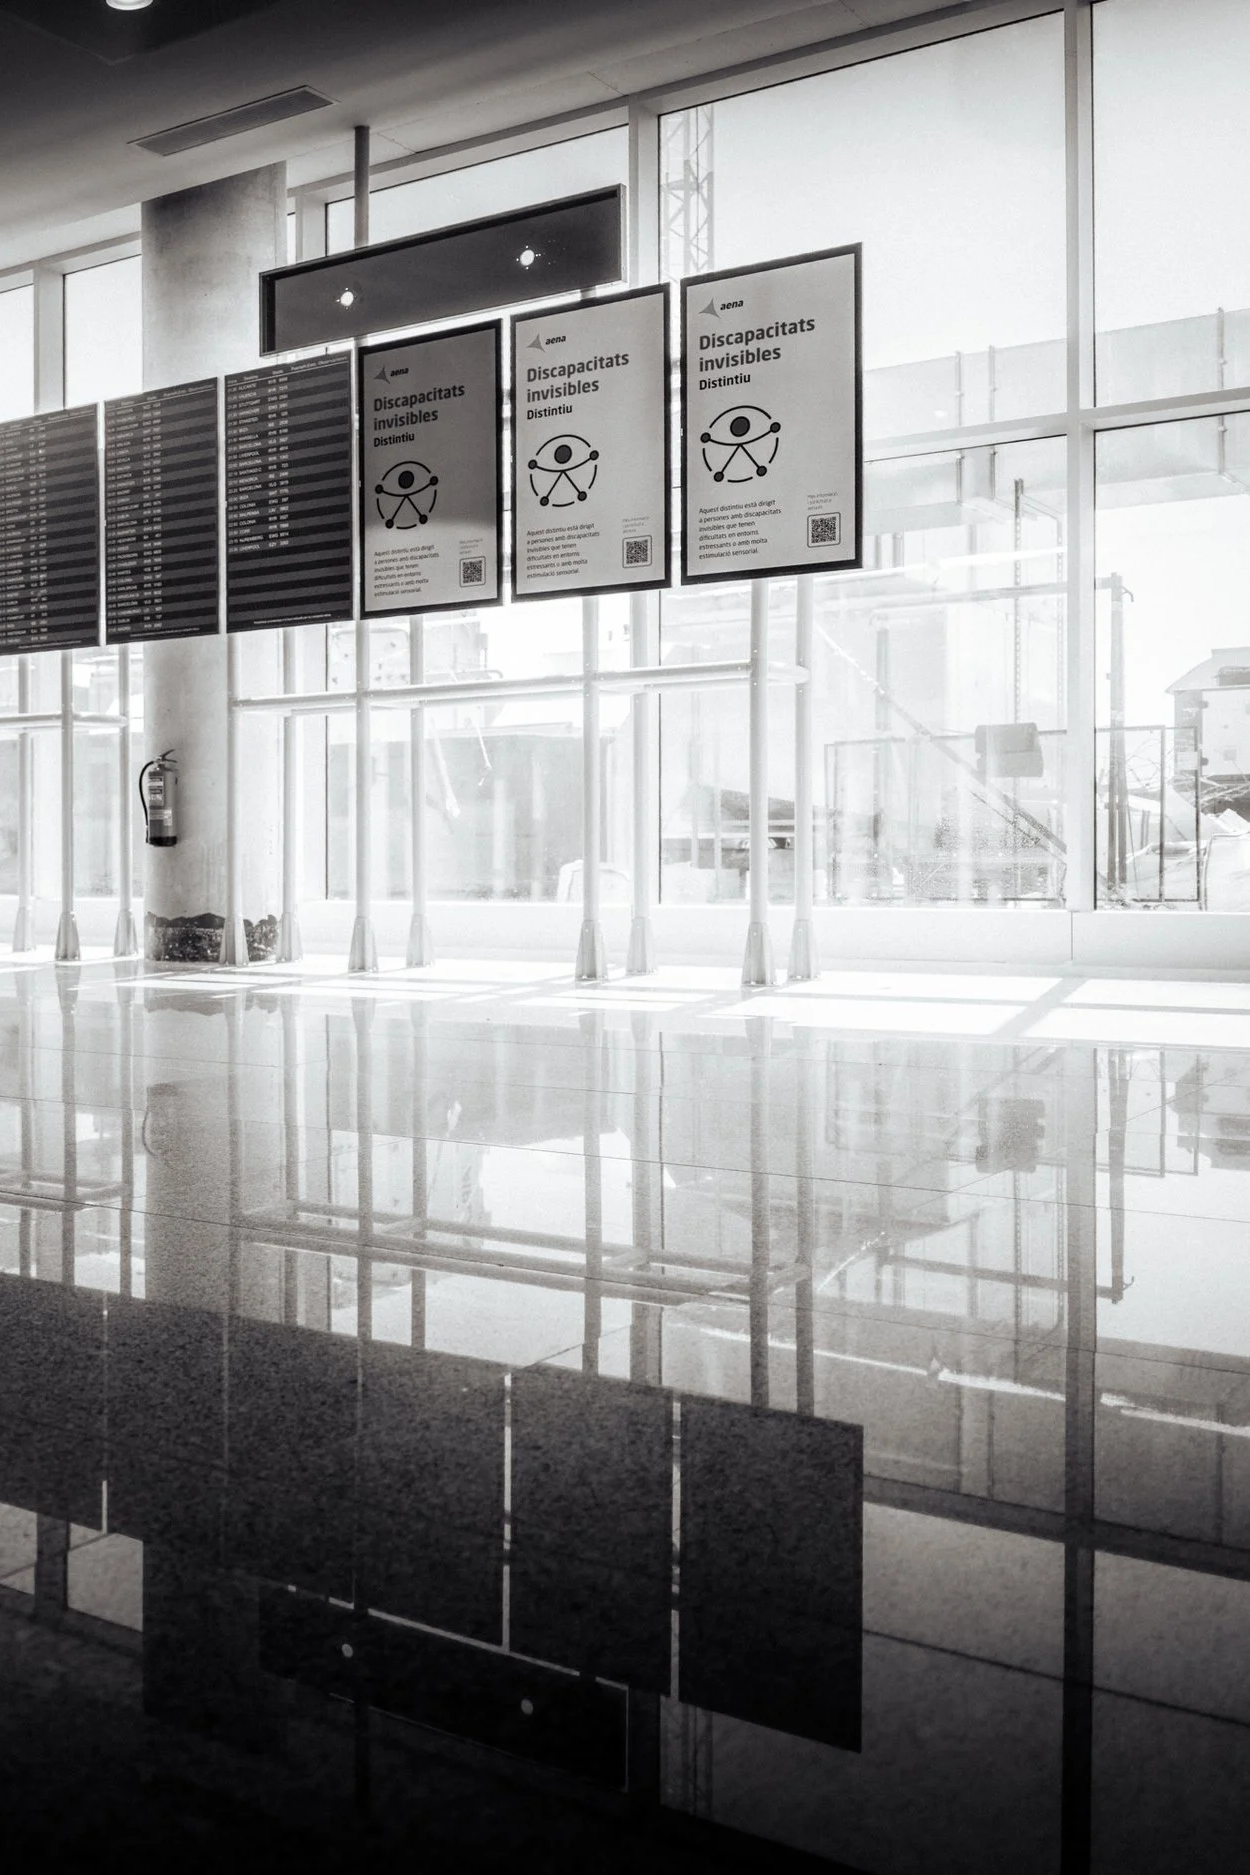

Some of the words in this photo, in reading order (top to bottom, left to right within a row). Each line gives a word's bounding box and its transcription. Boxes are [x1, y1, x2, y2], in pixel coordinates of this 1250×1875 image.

[720, 300, 743, 310] aena
[546, 336, 566, 345] aena
[700, 319, 815, 350] Discapacitats
[700, 347, 781, 372] invisibles
[390, 368, 409, 376] aena
[527, 354, 629, 382] Discapacitats
[700, 373, 750, 390] Distintiu
[374, 385, 465, 411] Discapacitats
[527, 380, 599, 402] invisibles
[527, 404, 572, 419] Distintiu
[374, 410, 438, 431] invisibles
[374, 432, 414, 447] Distintiu
[699, 504, 718, 514] Aquest
[720, 502, 743, 512] distintiu
[758, 500, 775, 508] dirigit
[703, 516, 729, 524] persones
[744, 509, 781, 519] discapacitats
[699, 524, 724, 532] invisibles
[699, 533, 727, 541] dificultats
[699, 542, 731, 550] estressants
[699, 550, 731, 559] estimulació
[732, 548, 758, 556] sensorial.
